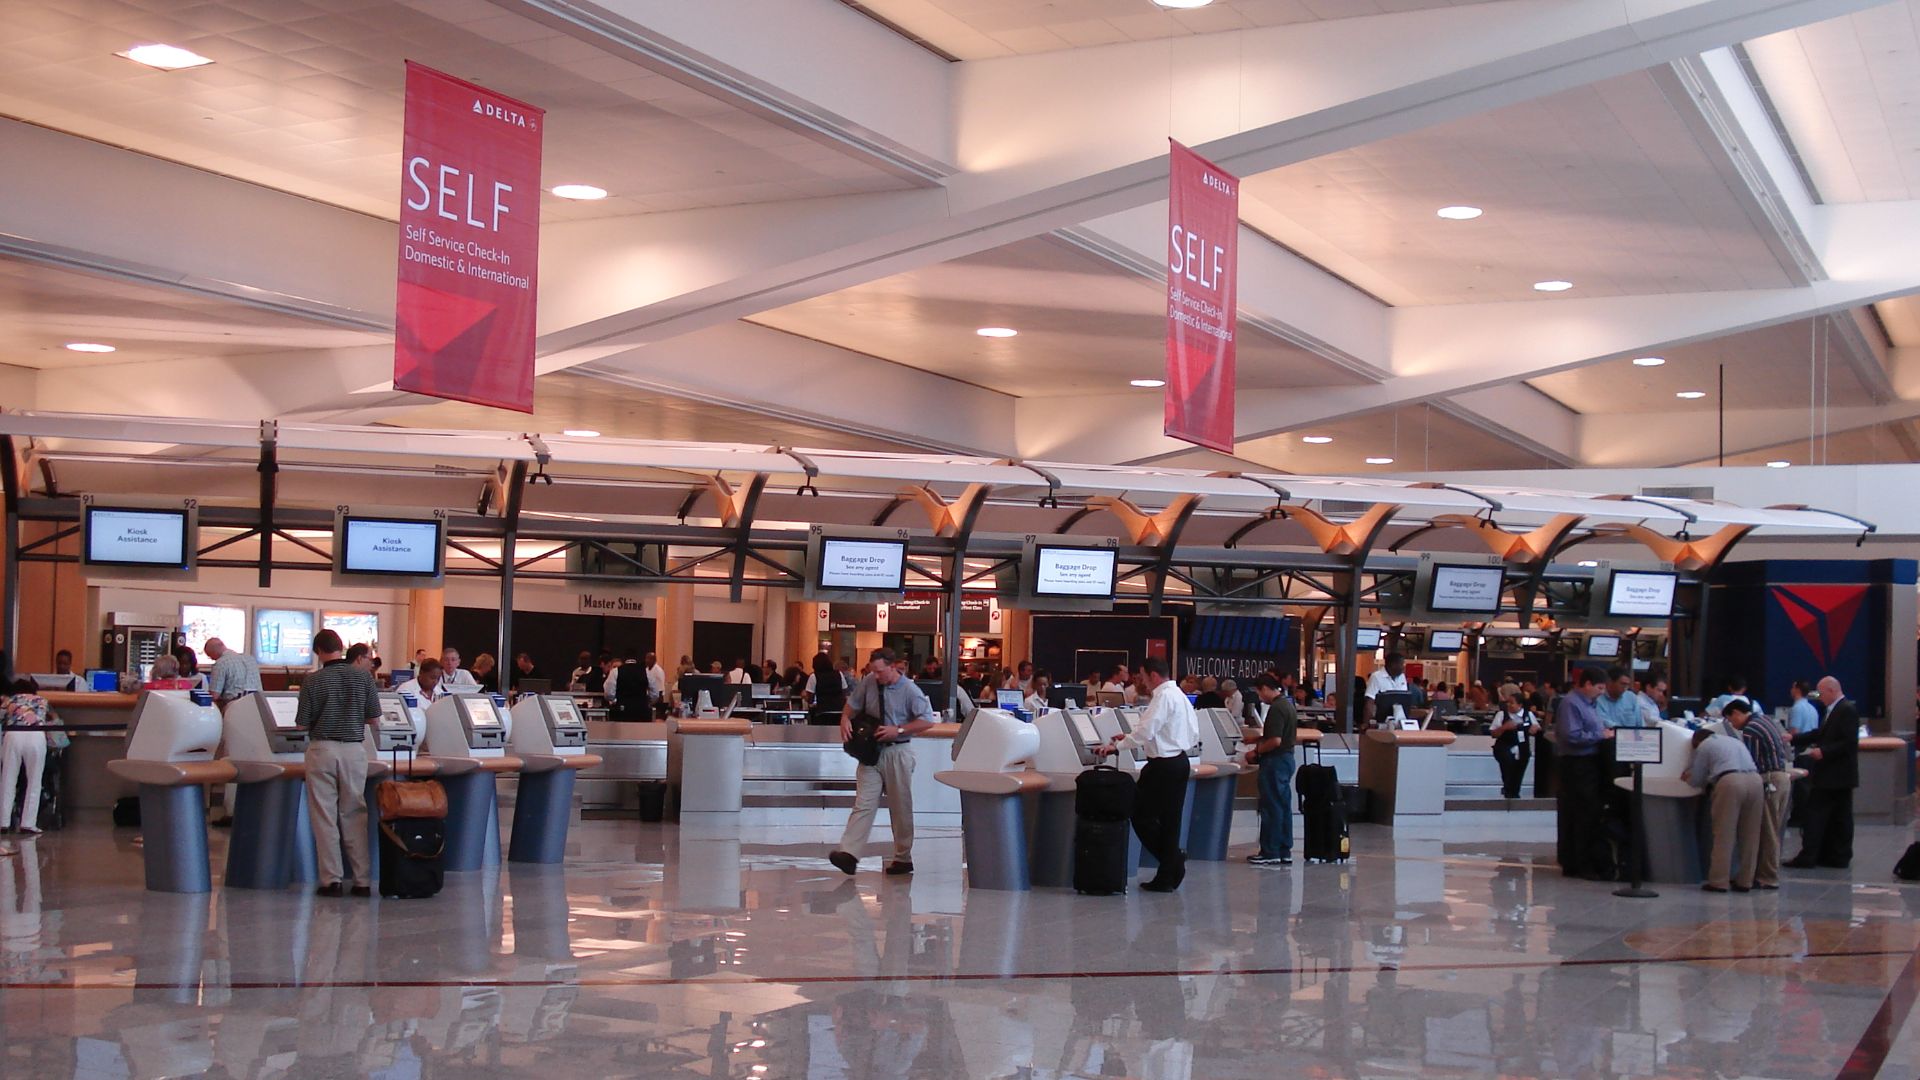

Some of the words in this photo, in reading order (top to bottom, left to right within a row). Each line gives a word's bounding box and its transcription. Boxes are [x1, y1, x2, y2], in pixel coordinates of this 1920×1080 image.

[486, 103, 525, 127] DELTA
[1209, 175, 1230, 196] DELTA
[408, 157, 513, 231] SELF
[406, 224, 426, 242] Self
[428, 231, 465, 253] Service
[467, 242, 510, 265] Check-In
[1171, 225, 1224, 291] SELF
[405, 245, 454, 270] Domestic
[457, 259, 465, 273] &
[468, 262, 529, 289] International
[1170, 286, 1181, 301] Self
[1182, 291, 1200, 311] Service
[1170, 304, 1195, 327] Domestic
[1195, 316, 1201, 329] &
[1201, 318, 1232, 341] International
[82, 495, 94, 504] 91
[184, 499, 197, 509] 92
[337, 505, 349, 515] 93
[433, 509, 446, 519] 94
[811, 526, 823, 535] 95
[897, 529, 908, 538] 96
[117, 535, 157, 543] Assistance
[1025, 535, 1036, 544] 97
[1106, 538, 1117, 547] 98
[372, 544, 411, 552] Assistance
[841, 555, 868, 564] Baggage
[584, 594, 615, 609] Master
[618, 597, 642, 611] Shine
[1186, 657, 1235, 678] WELCOME
